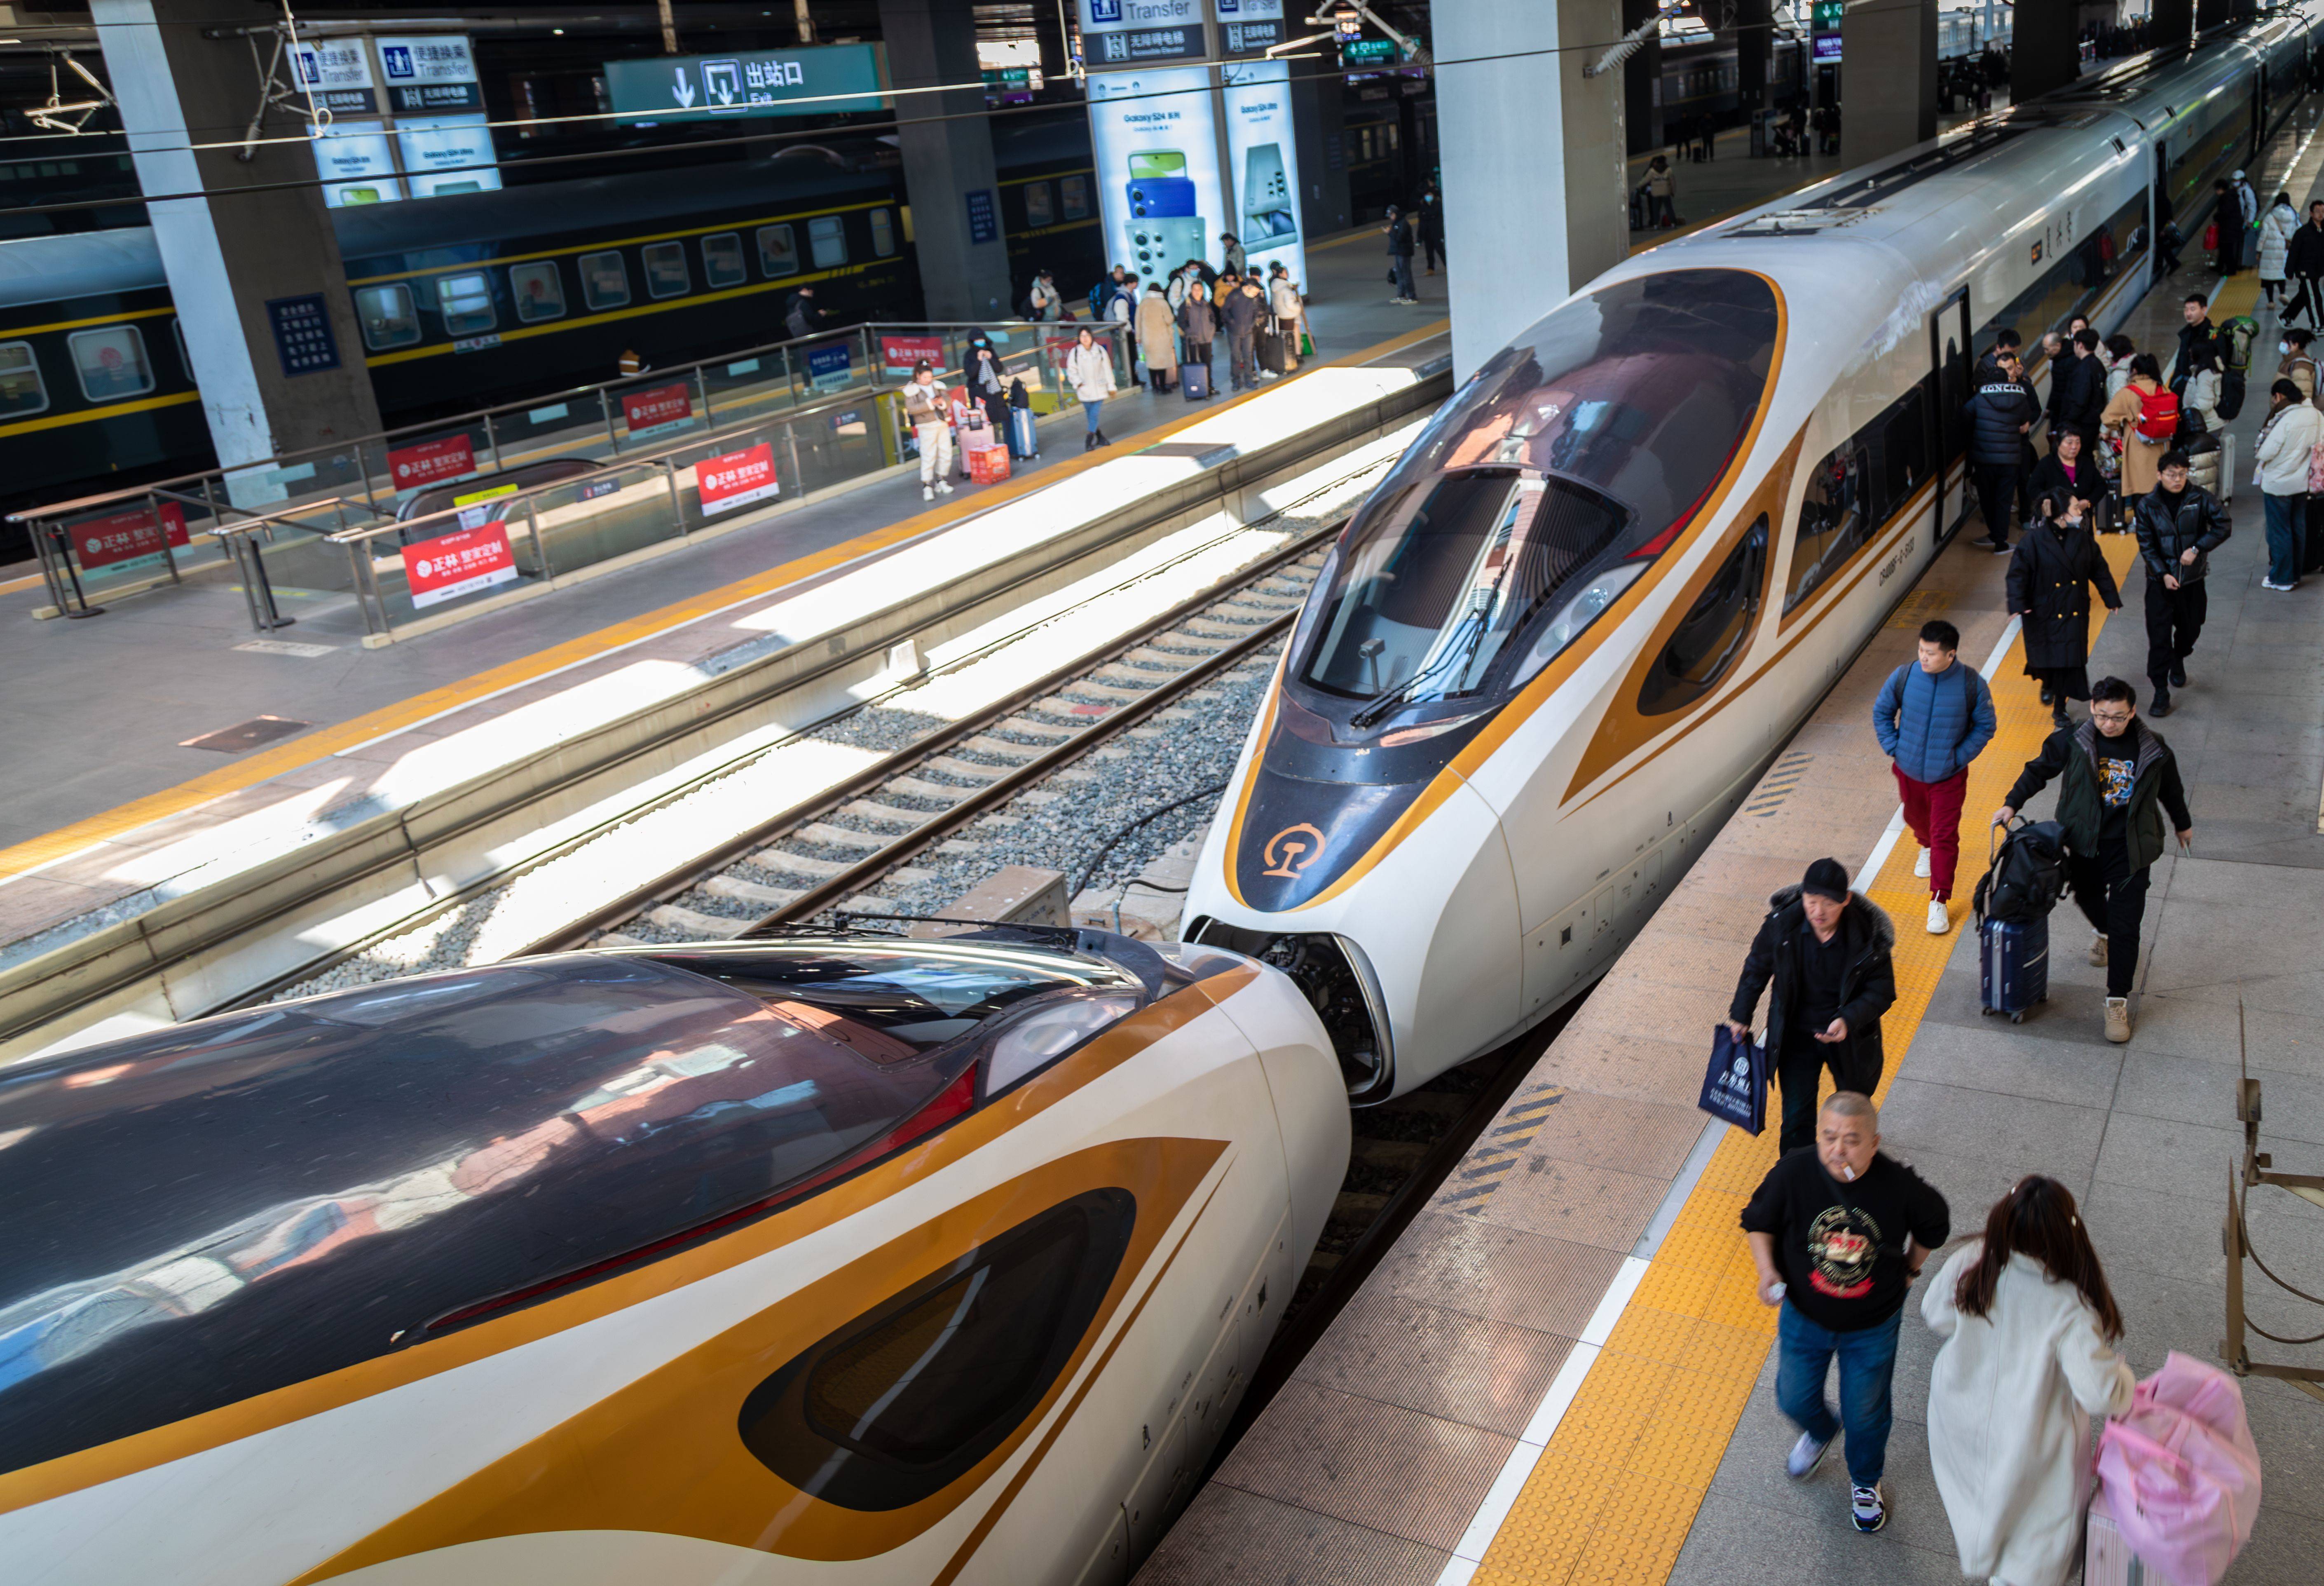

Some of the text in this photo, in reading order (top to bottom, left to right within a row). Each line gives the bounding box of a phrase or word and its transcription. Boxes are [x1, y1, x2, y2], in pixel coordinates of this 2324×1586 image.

[1126, 0, 1190, 19] Transfer
[321, 66, 364, 82] Transfer
[417, 62, 468, 77] Transfer
[745, 60, 803, 88] 出站口
[750, 92, 773, 108] Exit
[1124, 114, 1151, 123] Galaxy
[1152, 113, 1166, 121] S24
